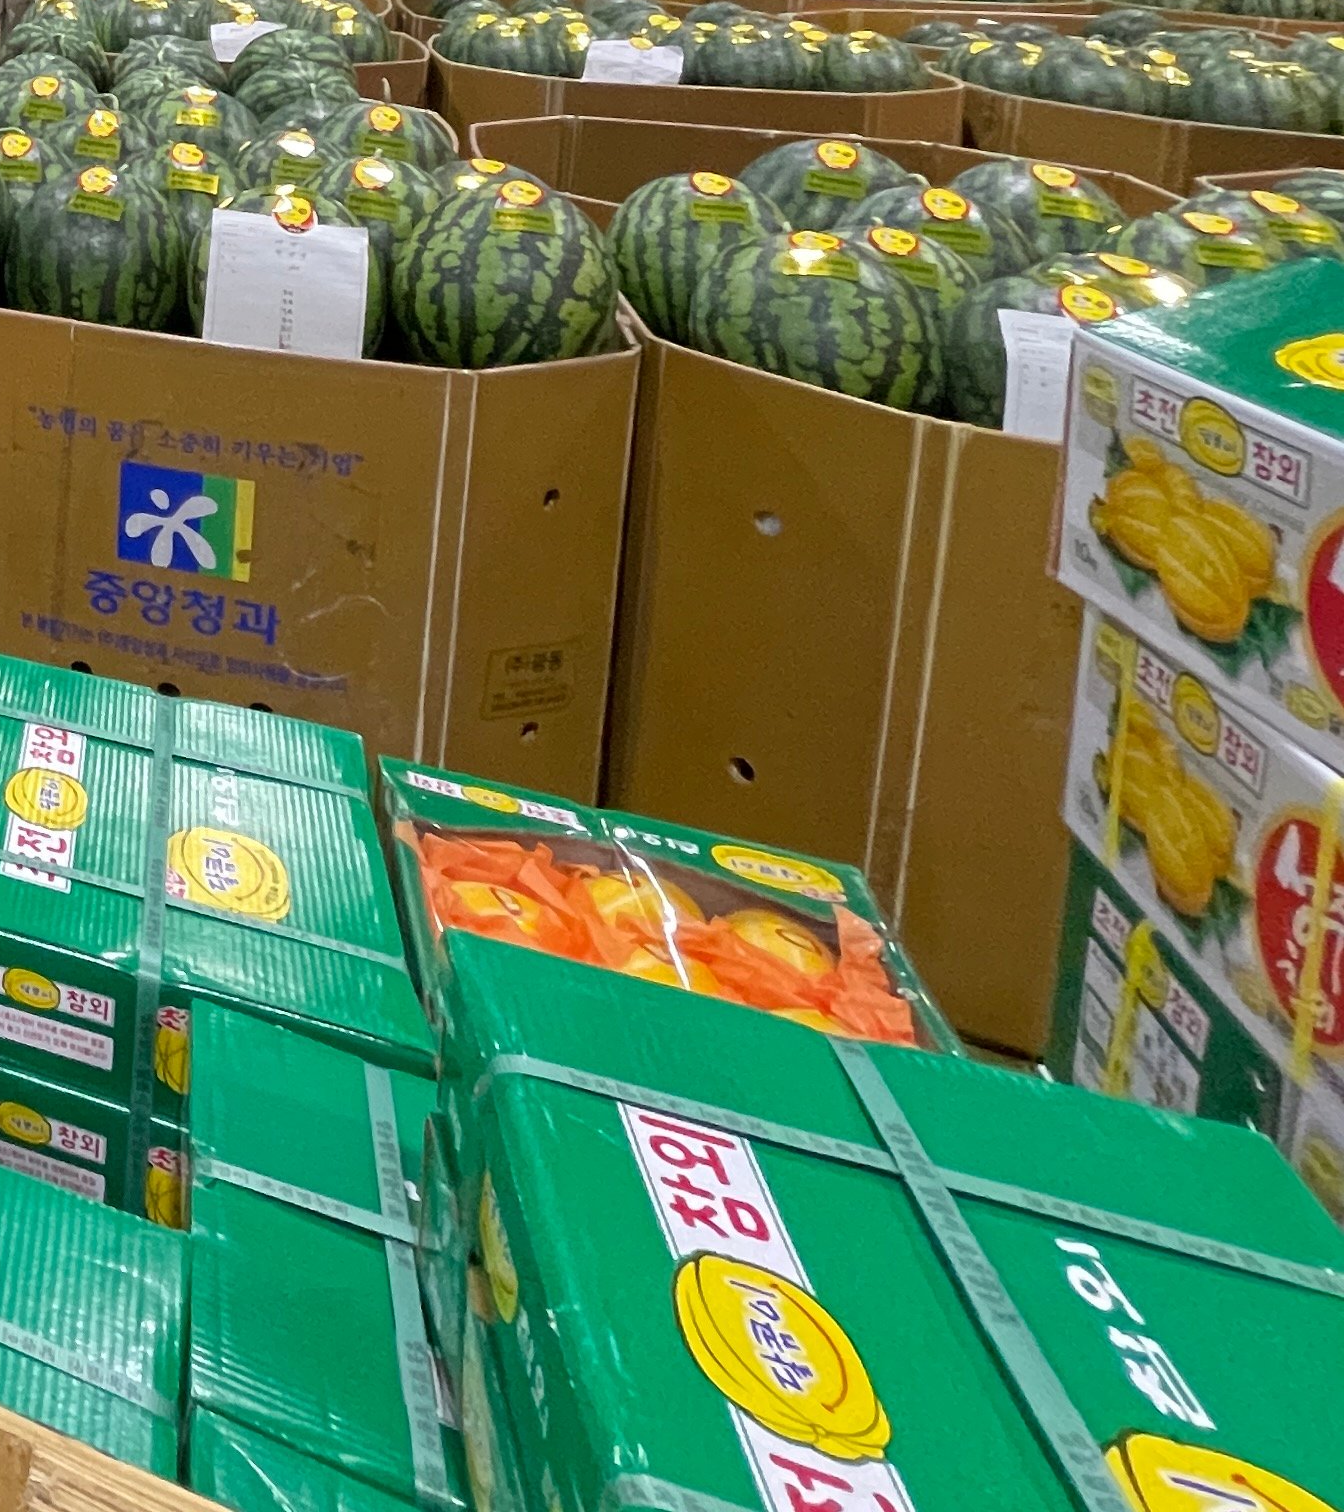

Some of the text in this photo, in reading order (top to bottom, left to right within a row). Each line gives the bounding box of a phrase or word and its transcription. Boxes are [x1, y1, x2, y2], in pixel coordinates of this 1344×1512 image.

[1135, 389, 1177, 435] 초전
[1253, 441, 1301, 498] 참외
[83, 569, 281, 647] 중앙청과
[67, 989, 109, 1022] 참외
[58, 1125, 101, 1159] 참외
[638, 1114, 771, 1244] 참외
[728, 1278, 815, 1393] 달콤이
[1054, 1237, 1218, 1431] 참외
